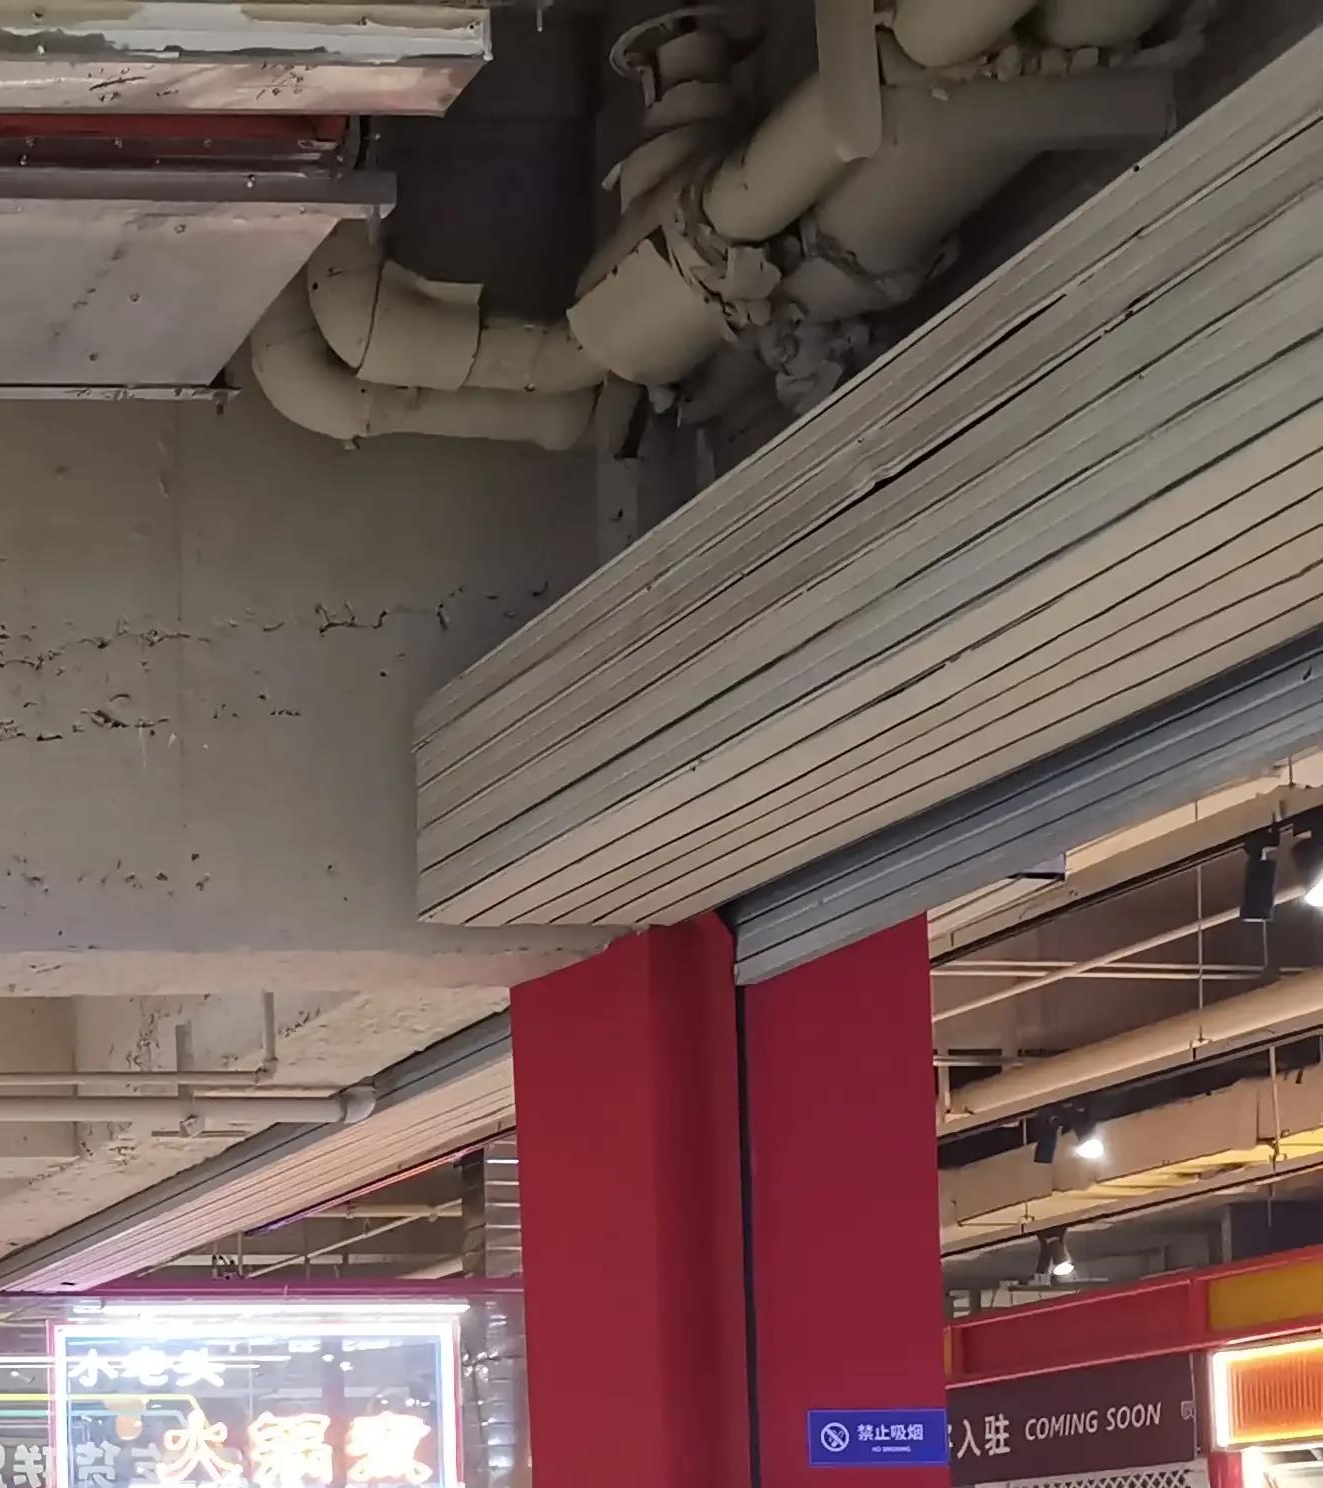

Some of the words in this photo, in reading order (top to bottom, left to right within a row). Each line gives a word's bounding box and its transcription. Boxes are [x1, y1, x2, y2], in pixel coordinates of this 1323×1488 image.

[857, 1424, 923, 1441] 禁止吸烟
[947, 1414, 1011, 1459] 入驻
[1025, 1411, 1098, 1442] COMING
[1106, 1403, 1162, 1432] SOON
